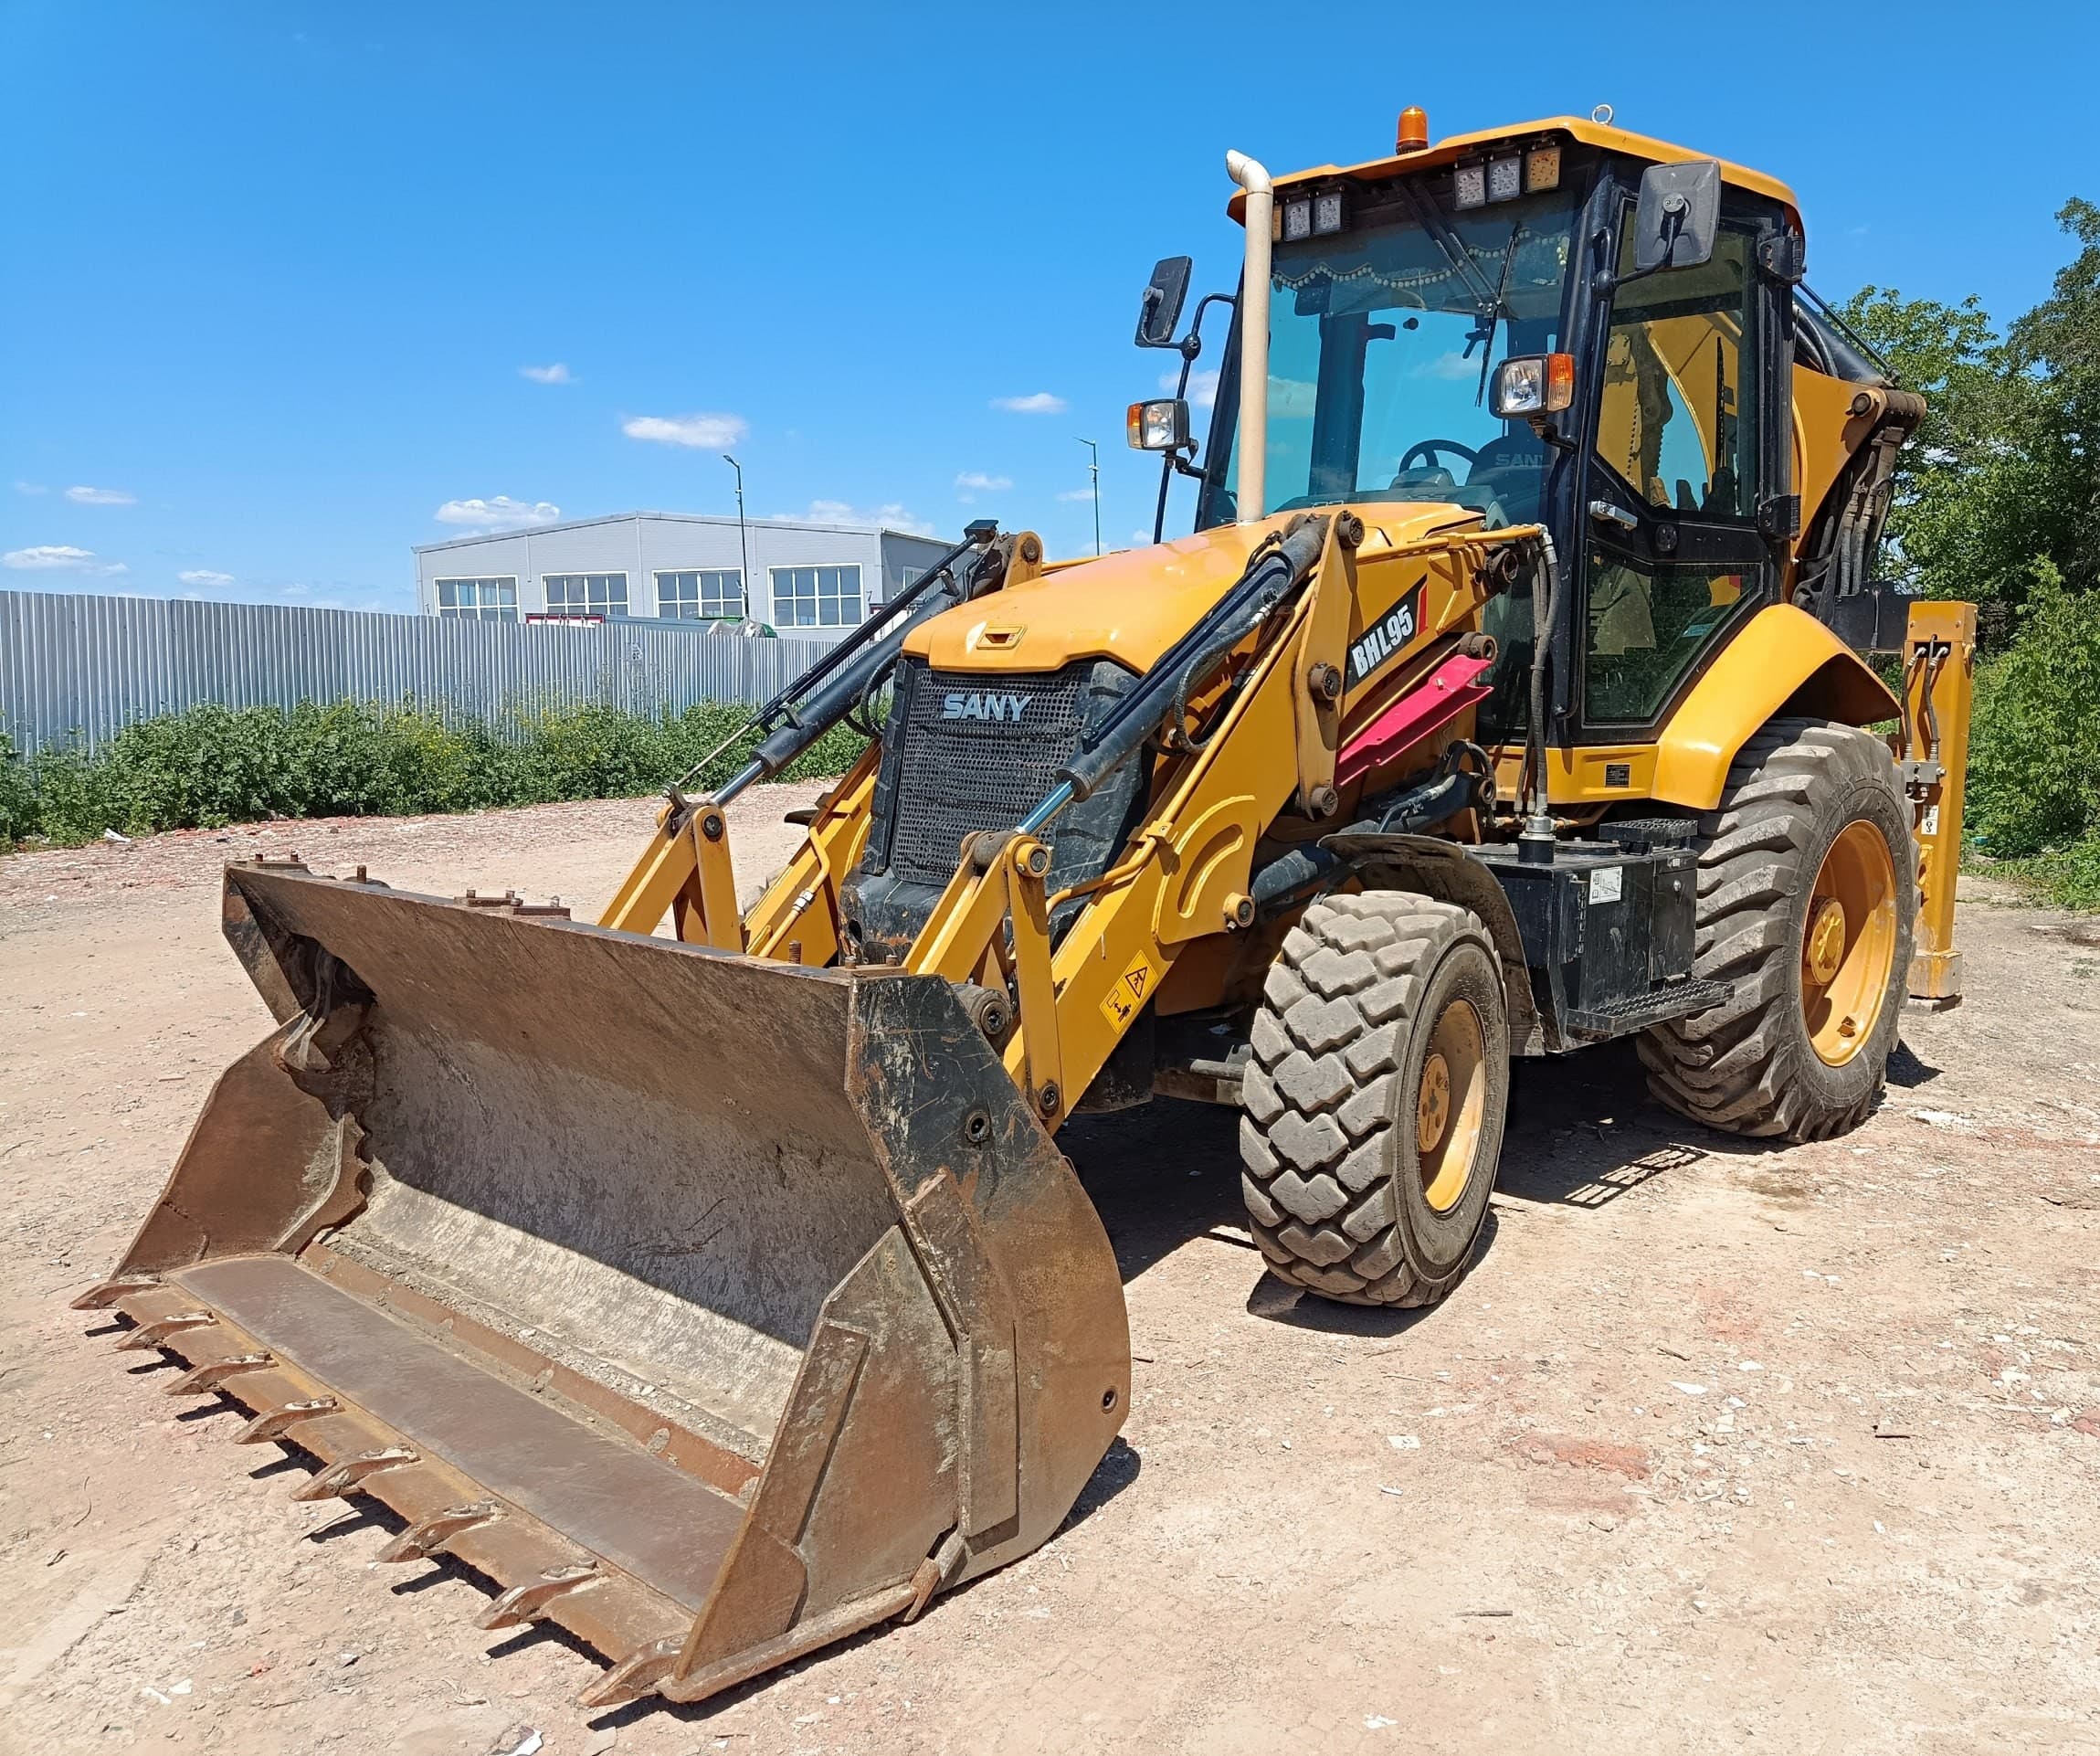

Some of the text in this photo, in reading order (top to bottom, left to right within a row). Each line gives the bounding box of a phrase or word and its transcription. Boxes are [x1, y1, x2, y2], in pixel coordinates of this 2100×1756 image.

[1495, 453, 1544, 469] SAN
[1352, 604, 1413, 678] BHL95
[943, 693, 1033, 722] SANY
